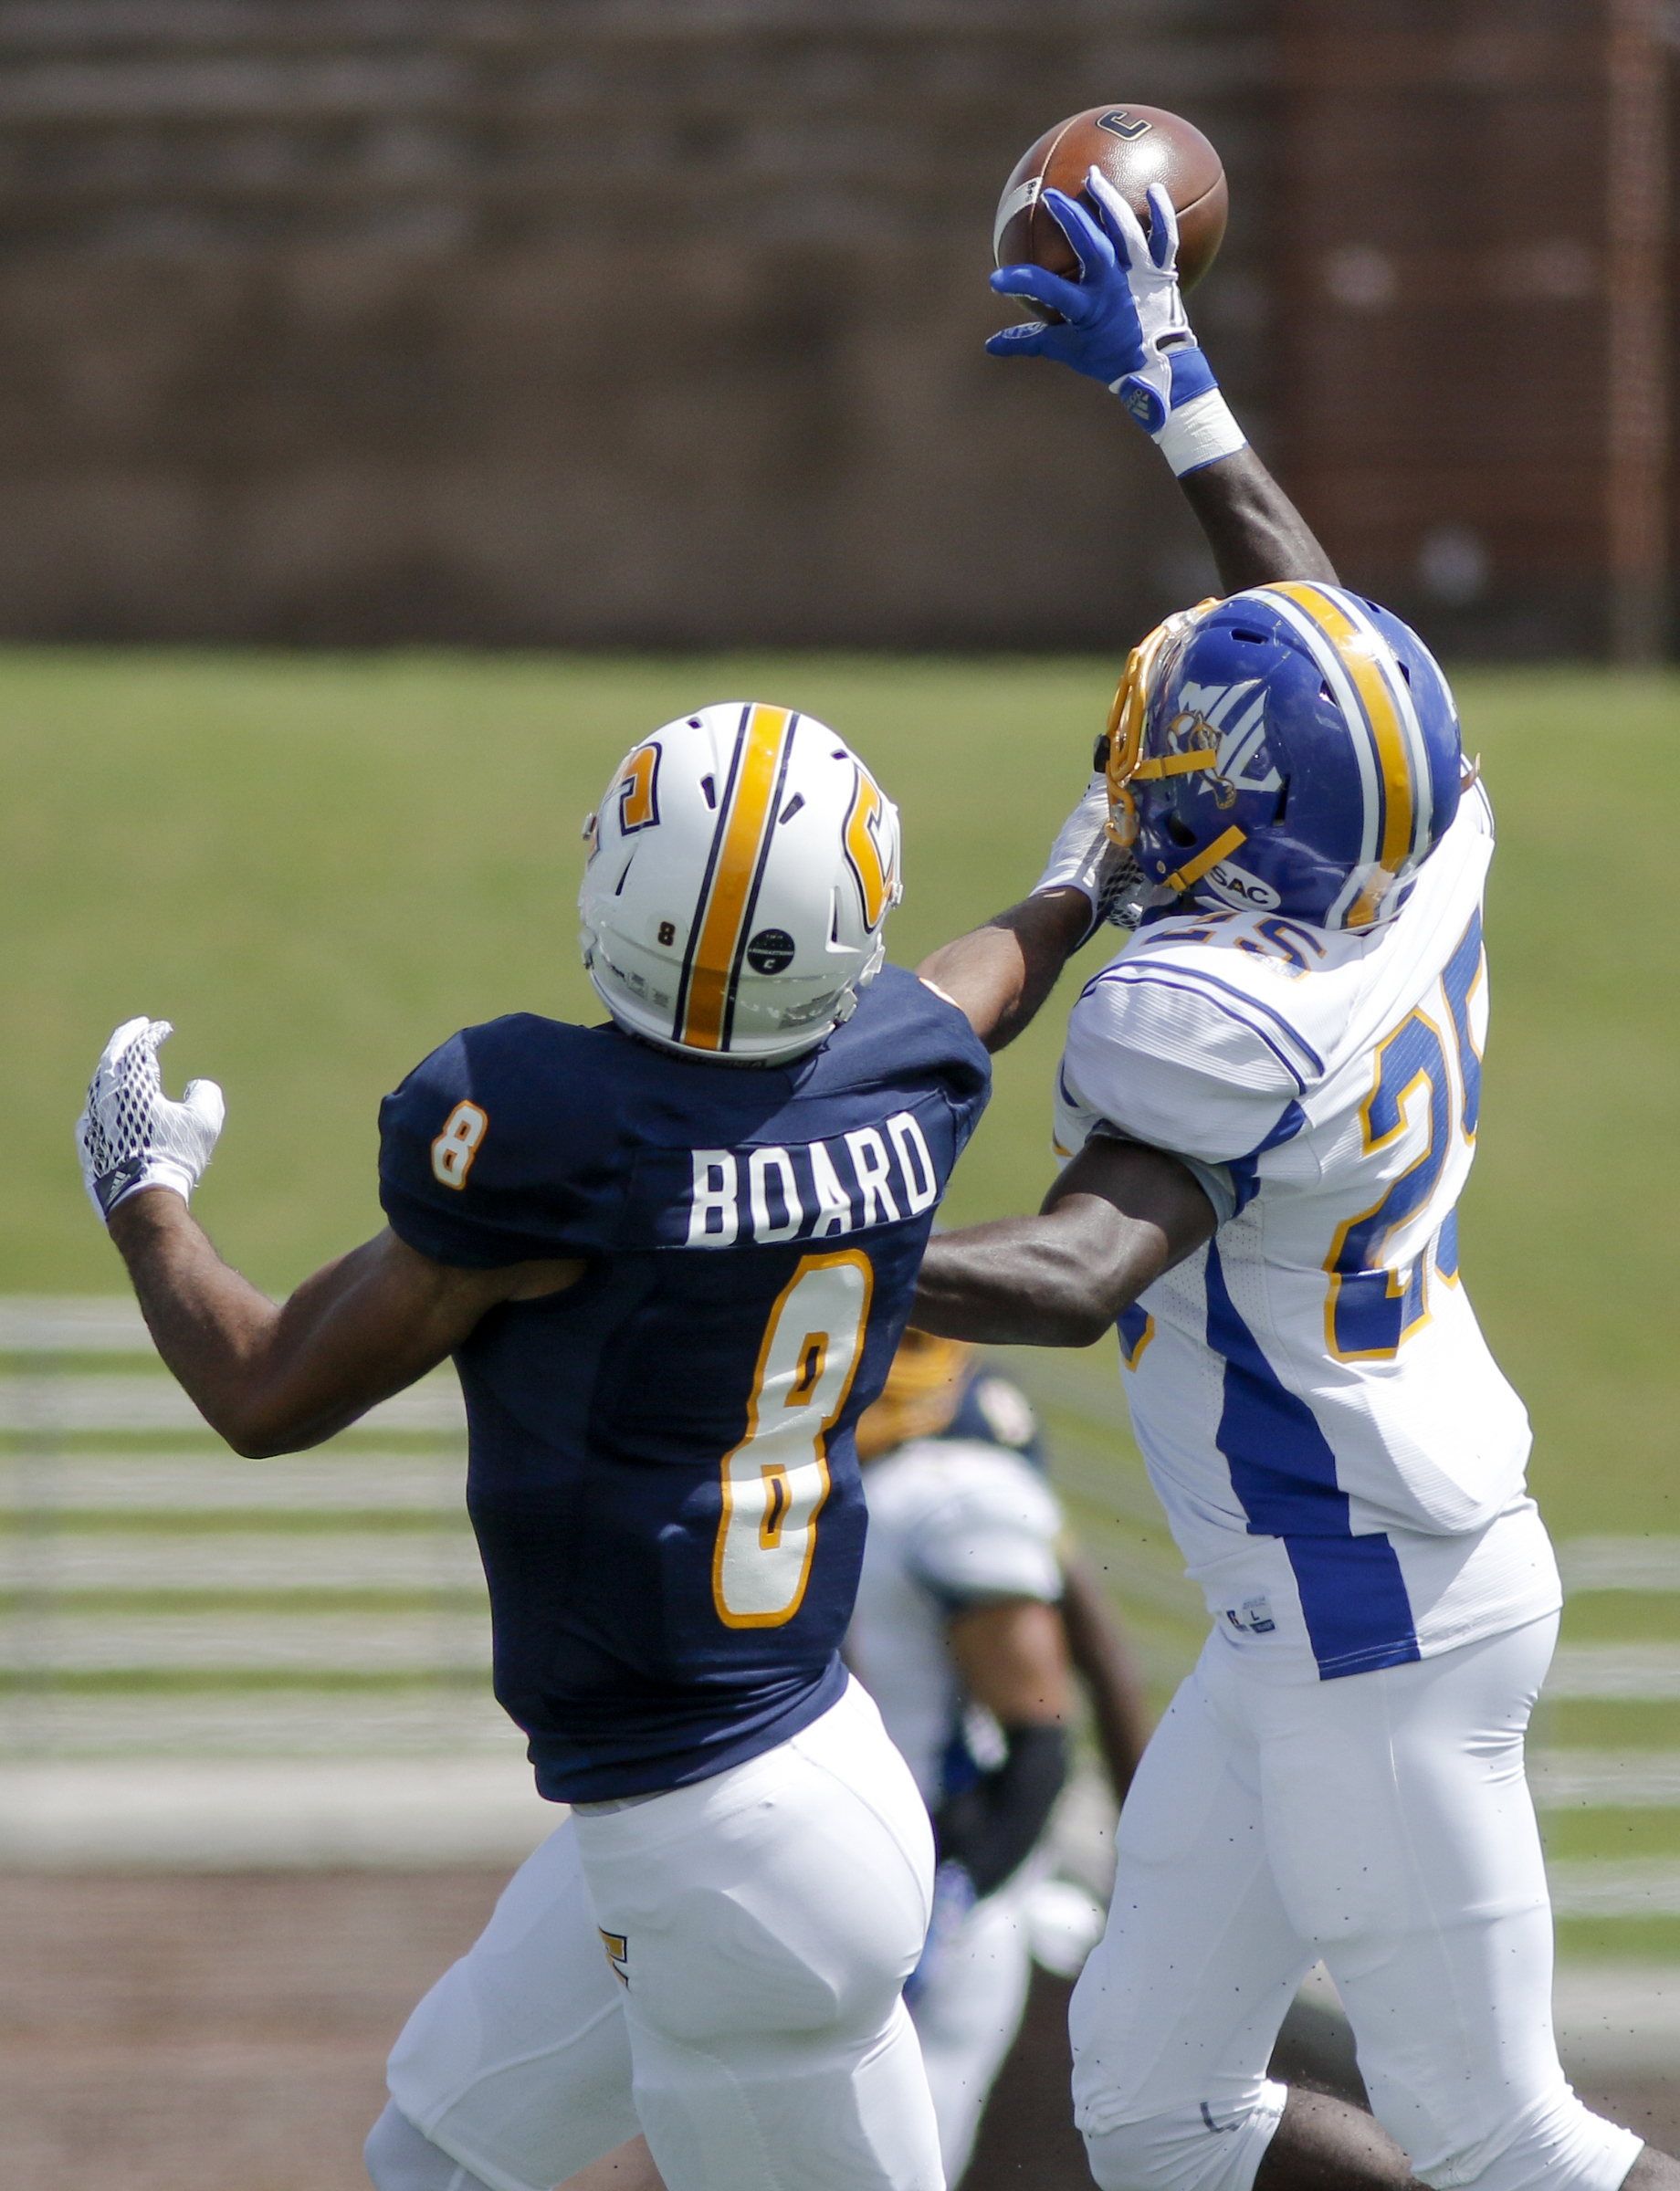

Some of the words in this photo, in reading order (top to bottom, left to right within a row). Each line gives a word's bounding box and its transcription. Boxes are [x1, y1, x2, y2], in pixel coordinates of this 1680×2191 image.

[1096, 109, 1153, 141] C
[657, 921, 677, 947] 8
[430, 1100, 488, 1190] 8
[685, 1110, 939, 1248] BOARD
[711, 1248, 874, 1630] 8
